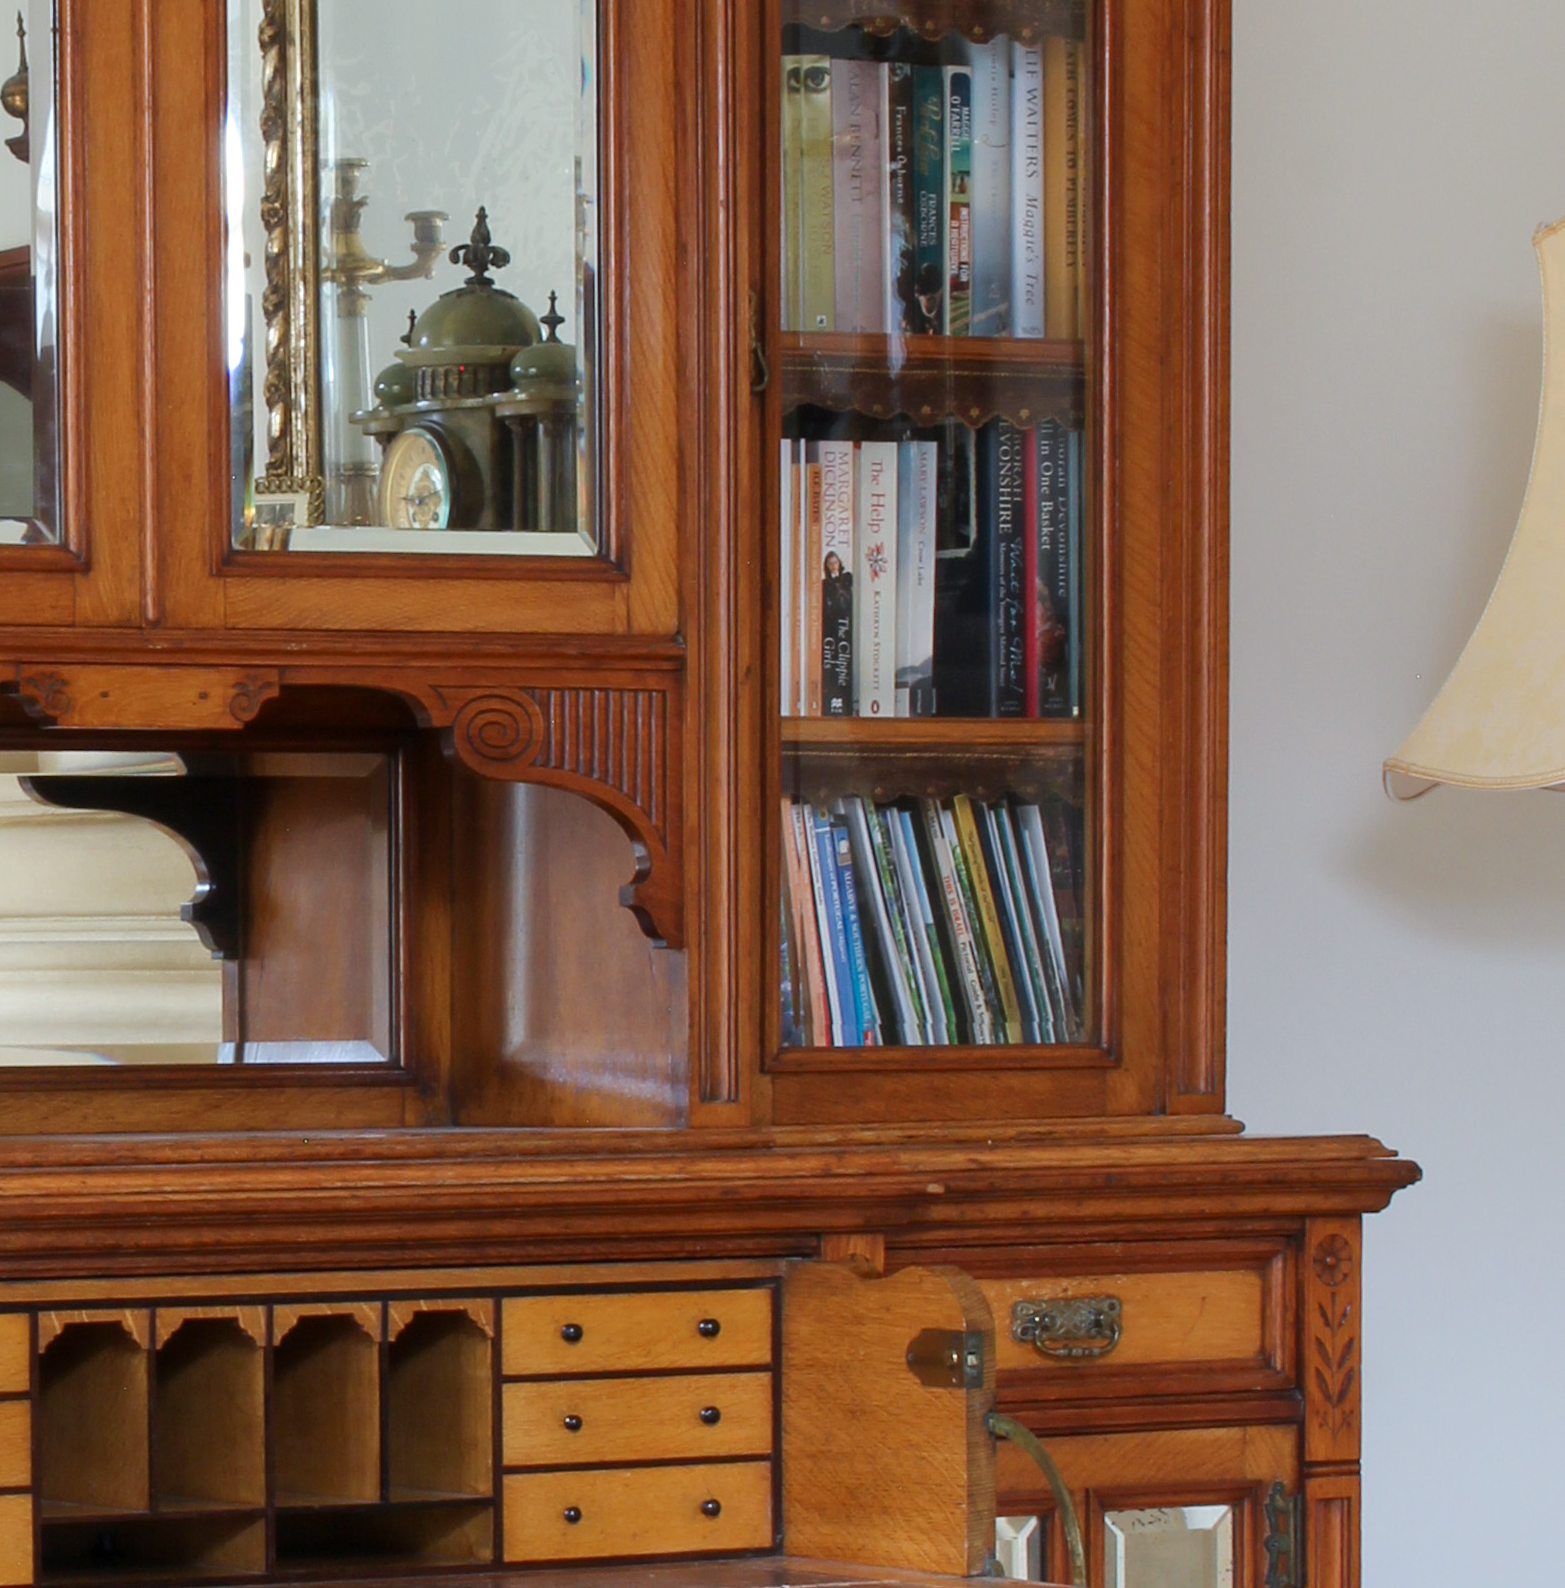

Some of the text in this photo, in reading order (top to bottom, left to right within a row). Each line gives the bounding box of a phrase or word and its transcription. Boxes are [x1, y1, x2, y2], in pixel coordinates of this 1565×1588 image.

[1024, 194, 1039, 264] Maggie's
[1025, 273, 1039, 306] Tree
[823, 450, 838, 547] DICKINSON
[838, 451, 850, 548] MARGARET
[871, 459, 884, 486] The
[1040, 440, 1054, 551] in One Basket
[867, 493, 885, 533] Help
[838, 617, 849, 638] The
